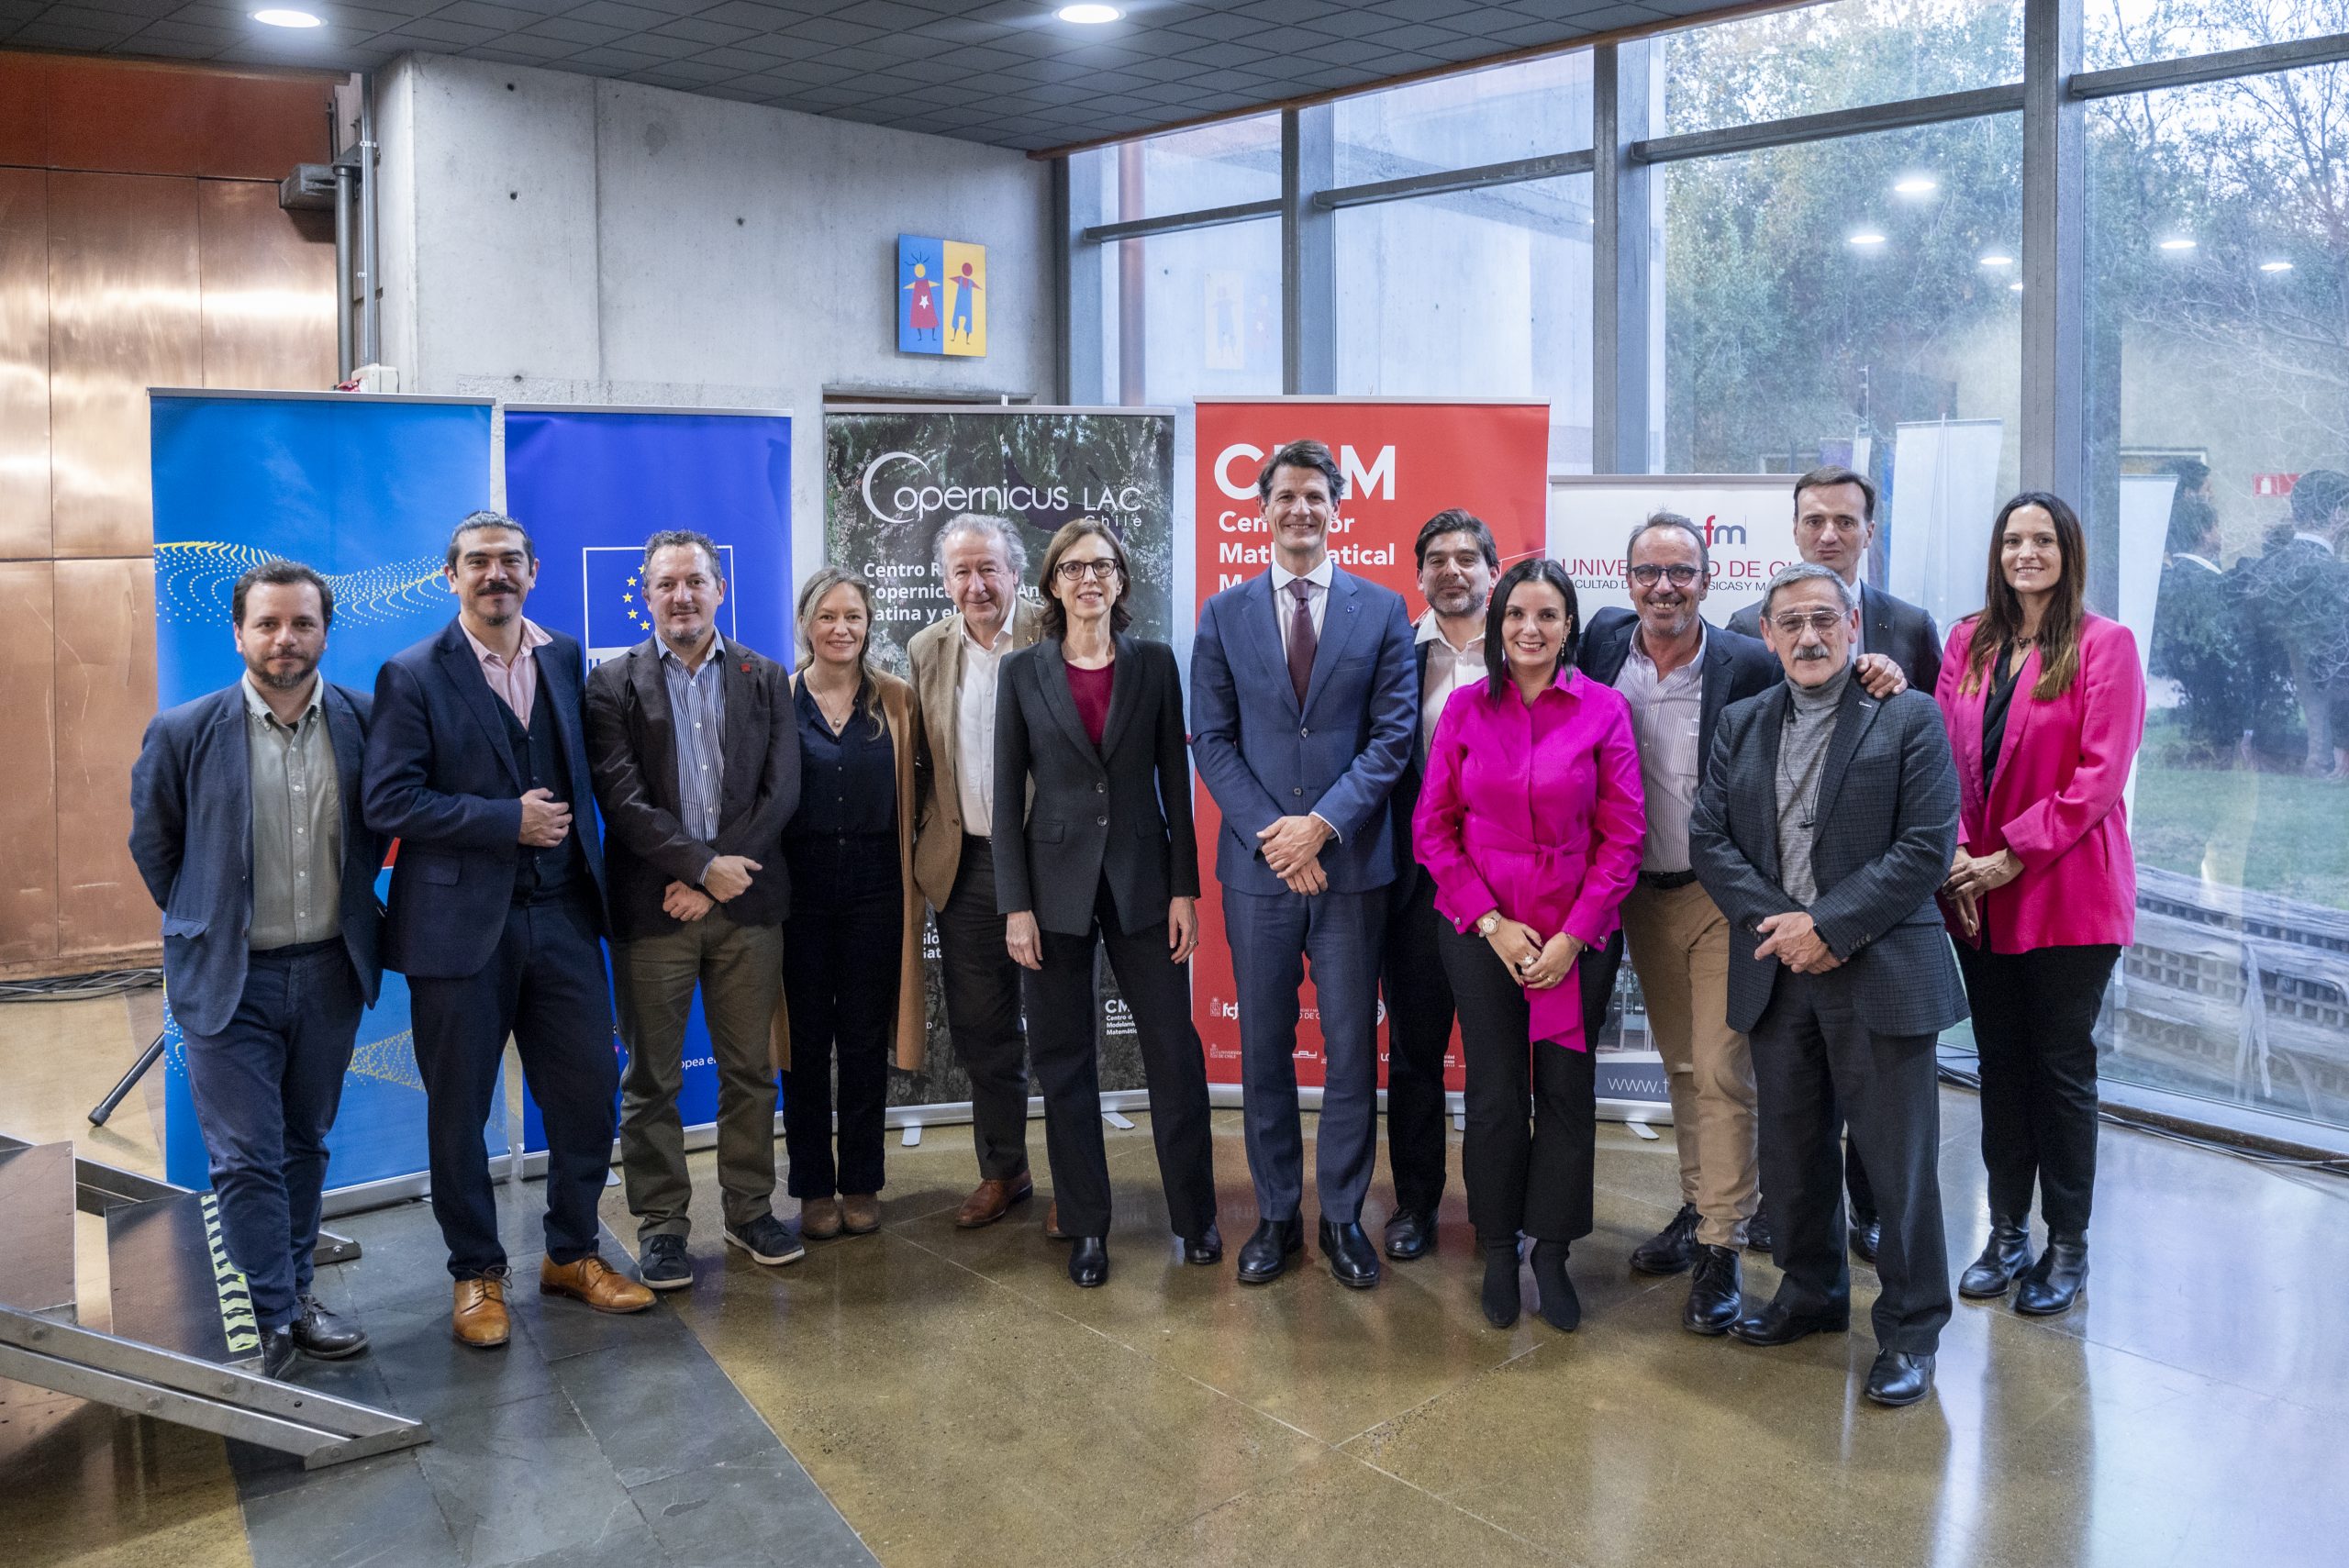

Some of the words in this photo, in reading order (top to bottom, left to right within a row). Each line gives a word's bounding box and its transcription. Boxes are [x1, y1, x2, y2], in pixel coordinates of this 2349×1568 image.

[1214, 443, 1396, 501] CM
[862, 451, 1069, 524] Copernicus
[1084, 487, 1141, 511] LAC
[1219, 510, 1272, 533] Cen
[1328, 517, 1355, 533] or
[1698, 515, 1746, 549] fm
[1219, 542, 1395, 565] Matatical
[863, 562, 925, 578] Centro
[1730, 561, 1760, 578] DE
[1572, 579, 1619, 589] CULTAD
[874, 606, 921, 621] atina
[926, 608, 938, 625] y
[1222, 1001, 1239, 1019] fcf
